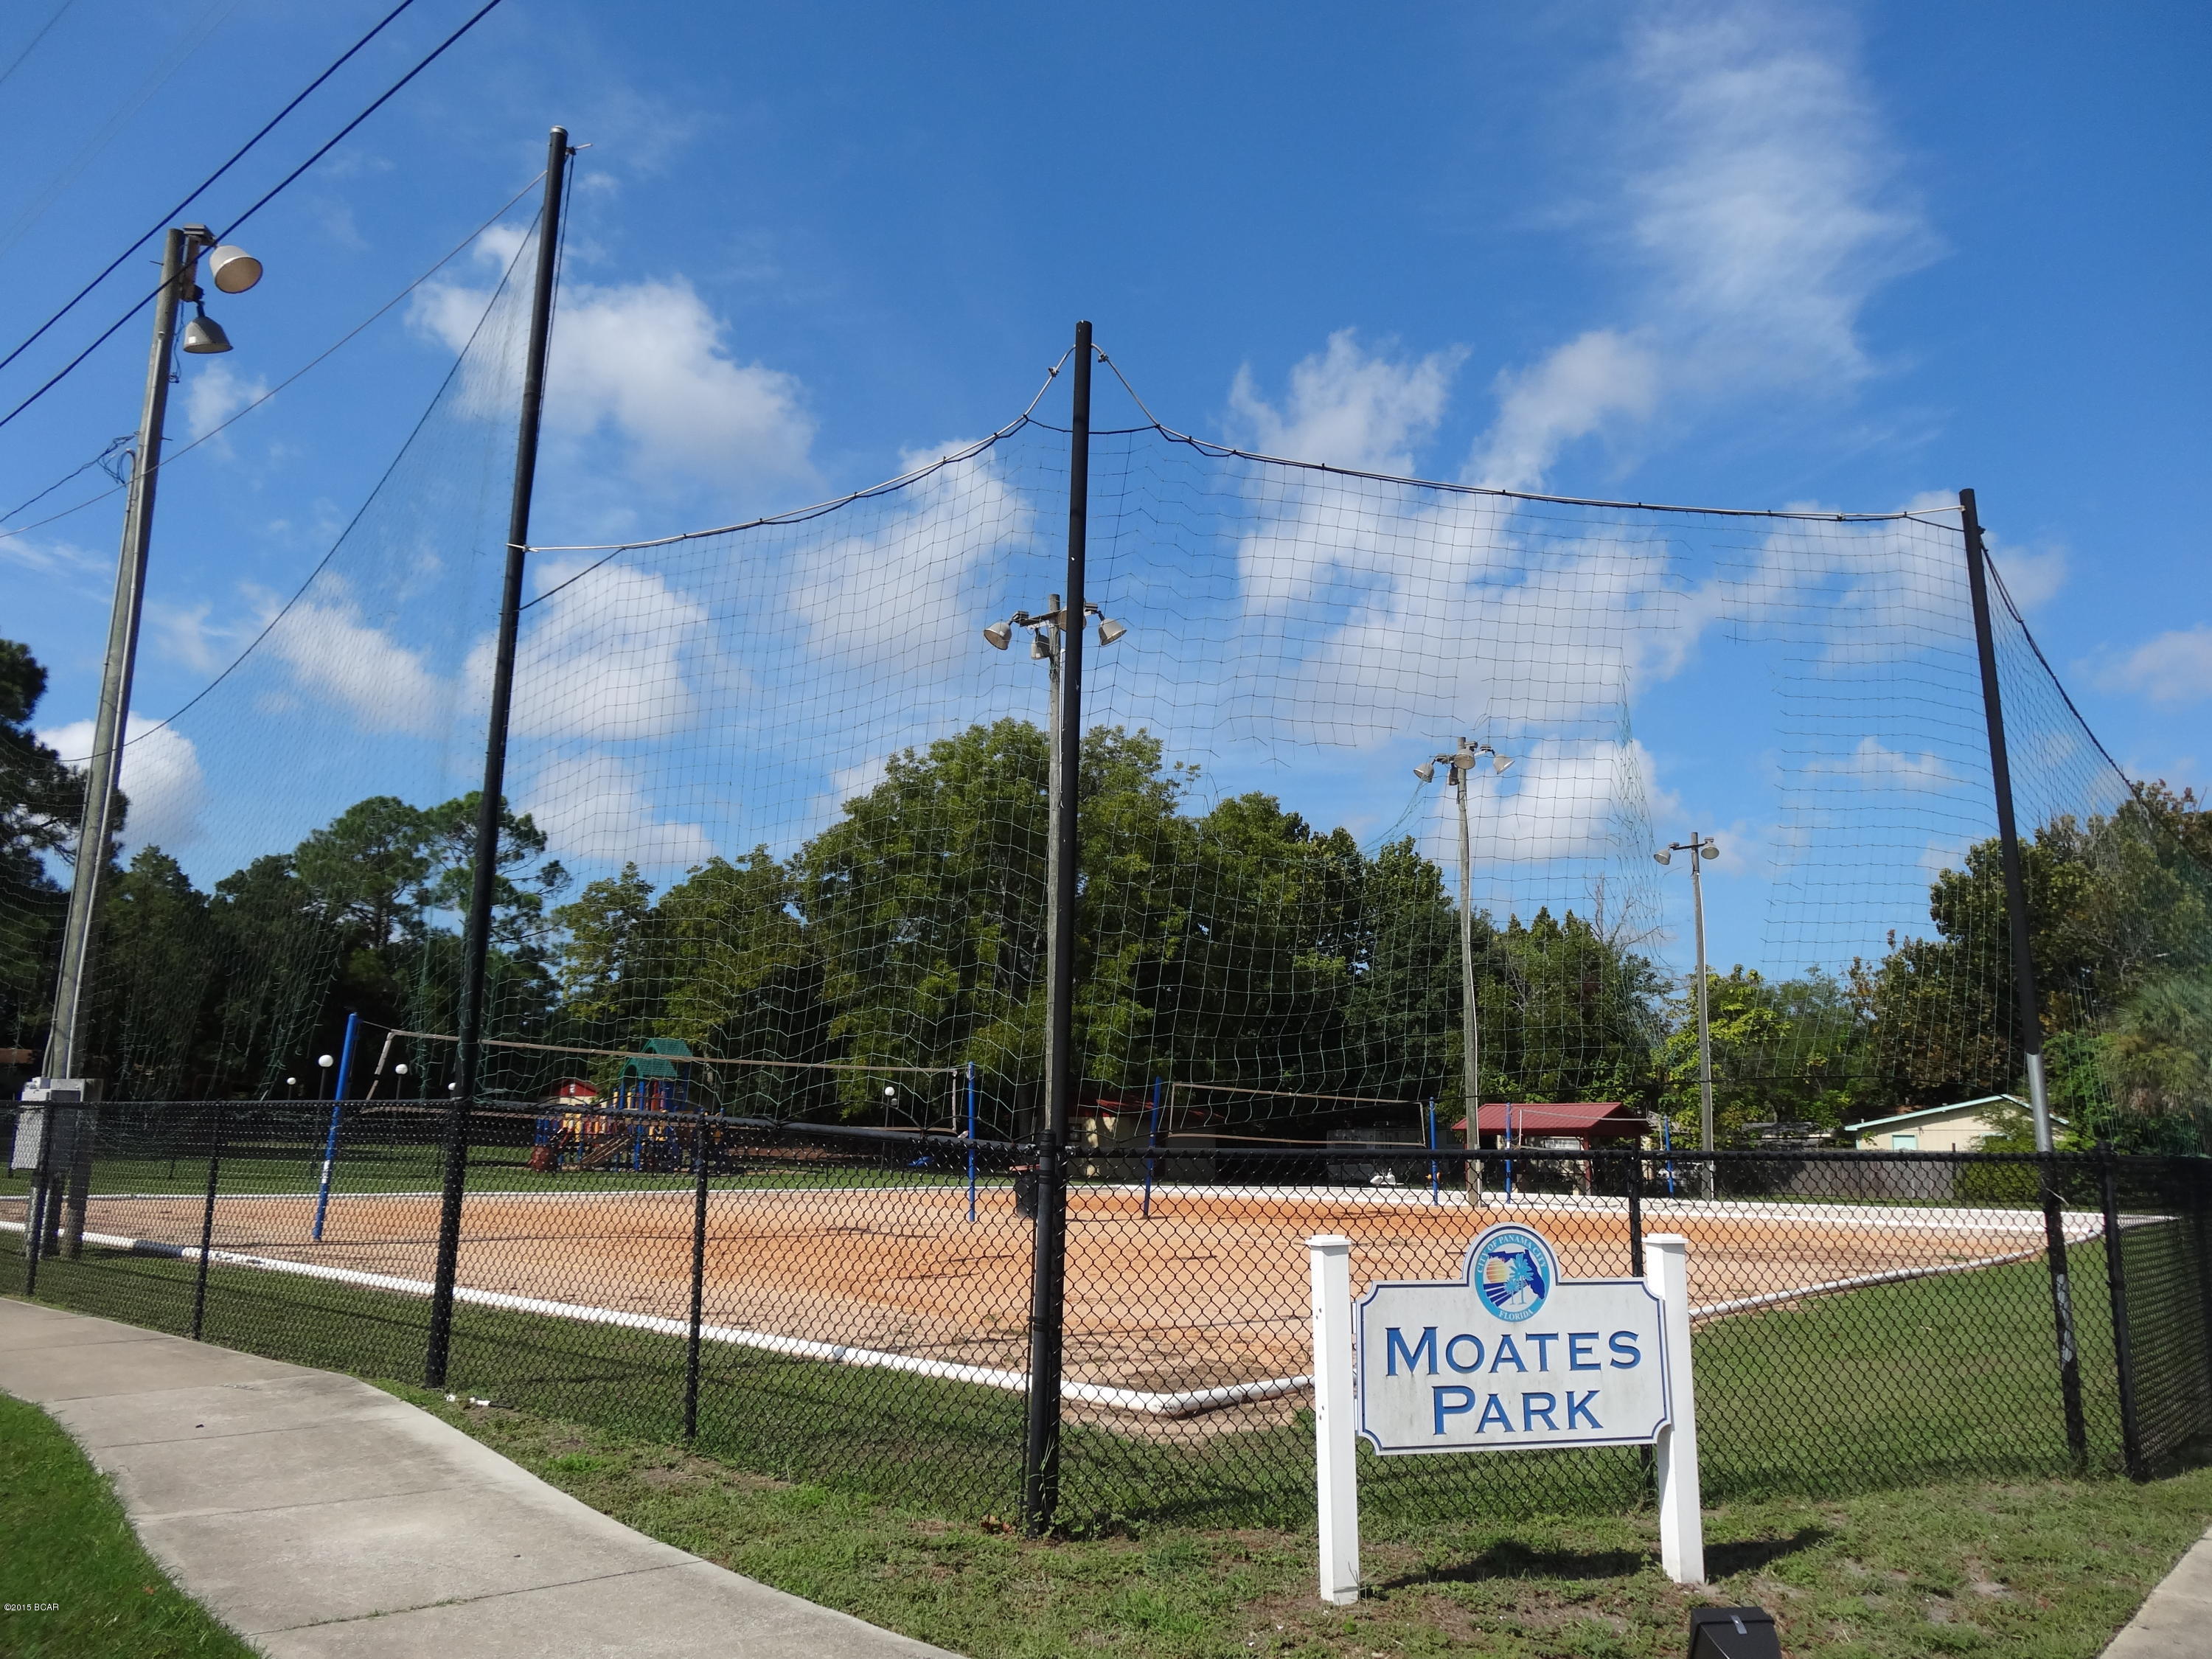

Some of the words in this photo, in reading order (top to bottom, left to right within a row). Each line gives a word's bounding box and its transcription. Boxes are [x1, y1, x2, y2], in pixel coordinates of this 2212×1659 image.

[1477, 1250, 1489, 1273] CITY
[1488, 1241, 1497, 1251] OF
[1499, 1234, 1531, 1249] PANAMA
[1533, 1246, 1546, 1268] CITY
[1499, 1309, 1534, 1320] FLORIDA
[1385, 1326, 1641, 1377] MOATES
[1432, 1385, 1603, 1436] PARK
